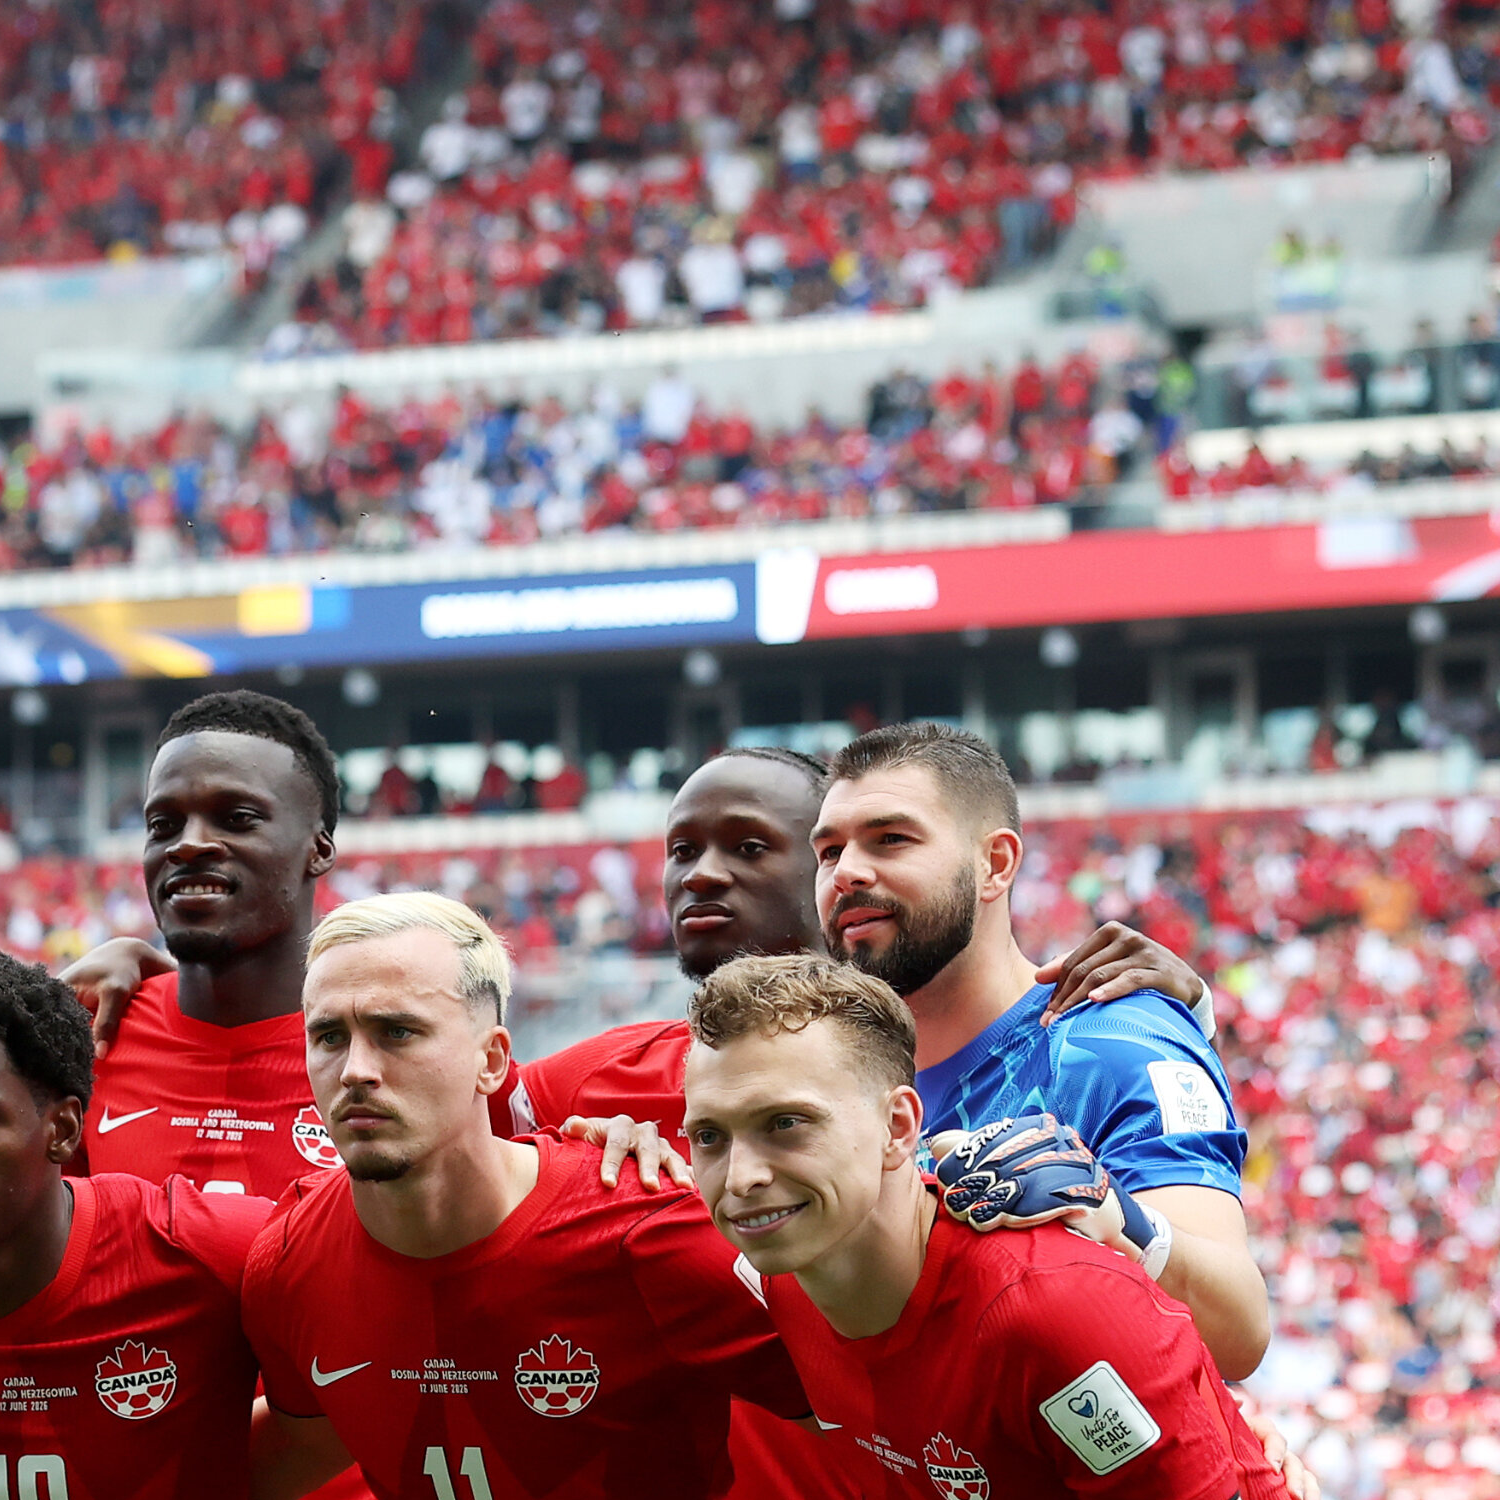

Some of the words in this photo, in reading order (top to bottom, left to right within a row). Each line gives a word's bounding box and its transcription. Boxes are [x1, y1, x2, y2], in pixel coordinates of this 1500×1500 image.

[207, 1109, 237, 1118] CANADA
[202, 1119, 218, 1128] AND
[295, 1126, 328, 1138] CAN
[423, 1359, 455, 1368] CANADA
[98, 1368, 175, 1392] CANADA
[391, 1370, 420, 1380] BOSNIA
[423, 1370, 440, 1380] AND
[442, 1371, 498, 1380] HERZEGOVINA
[516, 1371, 597, 1385] CANADA
[3, 1377, 35, 1387] CANADA
[2, 1390, 18, 1399] AND
[20, 1387, 78, 1399] HERZEGOVINA
[419, 1384, 427, 1393] 12
[430, 1384, 448, 1393] JUNE
[451, 1384, 468, 1393] 2026
[0, 1402, 7, 1411] 12
[9, 1401, 28, 1411] JUNE
[31, 1401, 48, 1411] 2026
[1080, 1418, 1107, 1441] Unite
[1102, 1408, 1120, 1425] For
[1093, 1421, 1131, 1451] PEACE
[1111, 1441, 1132, 1456] FIFA
[928, 1465, 986, 1481] CANADA
